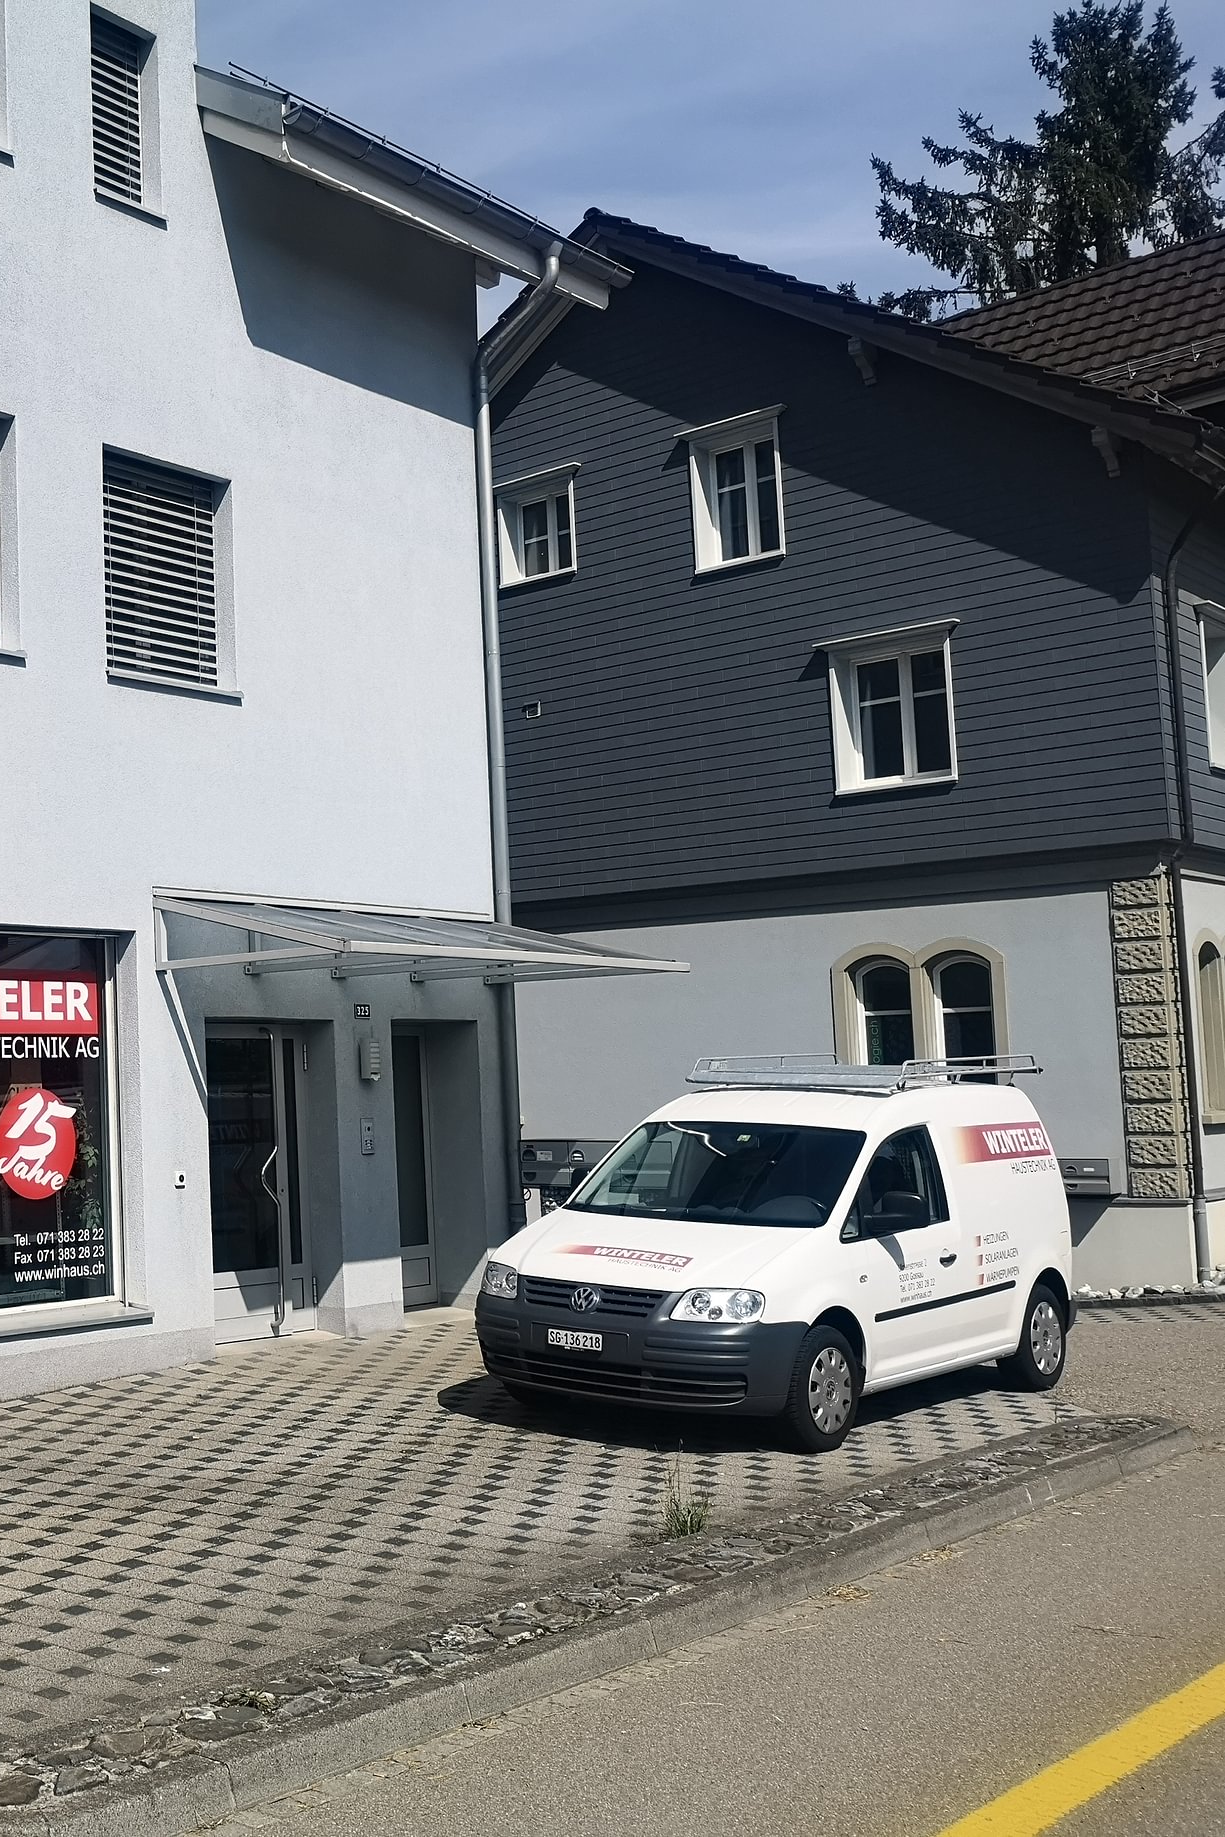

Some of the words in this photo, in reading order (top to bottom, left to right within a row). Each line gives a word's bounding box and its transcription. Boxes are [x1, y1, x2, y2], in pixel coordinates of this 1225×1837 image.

[356, 1006, 369, 1016] 325
[75, 1037, 100, 1059] AG
[5, 1093, 76, 1160] 15
[982, 1128, 1049, 1154] WINTELER
[1010, 1160, 1047, 1174] HAUSTECHNIK
[1047, 1158, 1056, 1171] AG
[14, 1233, 31, 1246] Tel.
[37, 1232, 54, 1245] 071
[58, 1230, 75, 1243] 383
[78, 1229, 90, 1241] 28
[92, 1228, 104, 1240] 22
[983, 1231, 1009, 1245] HEIZUNGEN
[14, 1252, 32, 1264] Fax
[37, 1249, 54, 1262] 071
[58, 1247, 76, 1260] 383
[78, 1246, 90, 1258] 28
[93, 1245, 105, 1257] 23
[593, 1247, 688, 1267] WINTELER
[985, 1248, 1019, 1264] SOLARANLAGEN
[14, 1261, 105, 1283] www.winhaus.ch
[607, 1258, 666, 1271] HAUSTECHNIK
